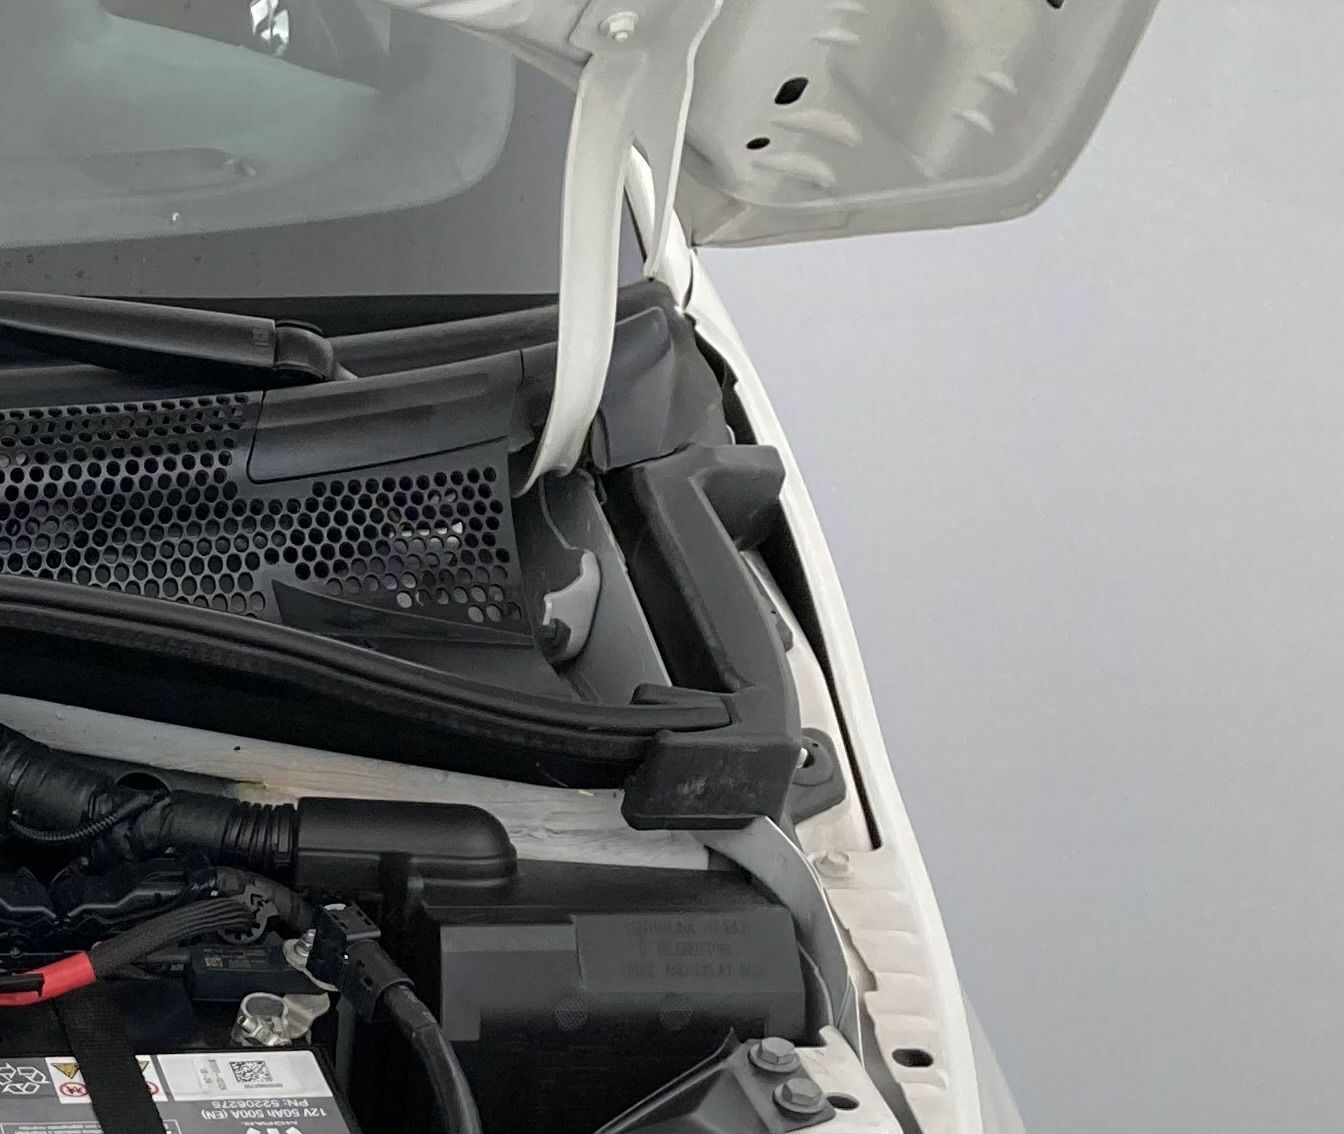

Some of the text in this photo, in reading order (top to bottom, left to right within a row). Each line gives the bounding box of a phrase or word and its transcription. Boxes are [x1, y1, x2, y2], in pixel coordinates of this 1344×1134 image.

[281, 1099, 309, 1107] PN:
[201, 1107, 328, 1120] 12V 50Ah 500A (EN)
